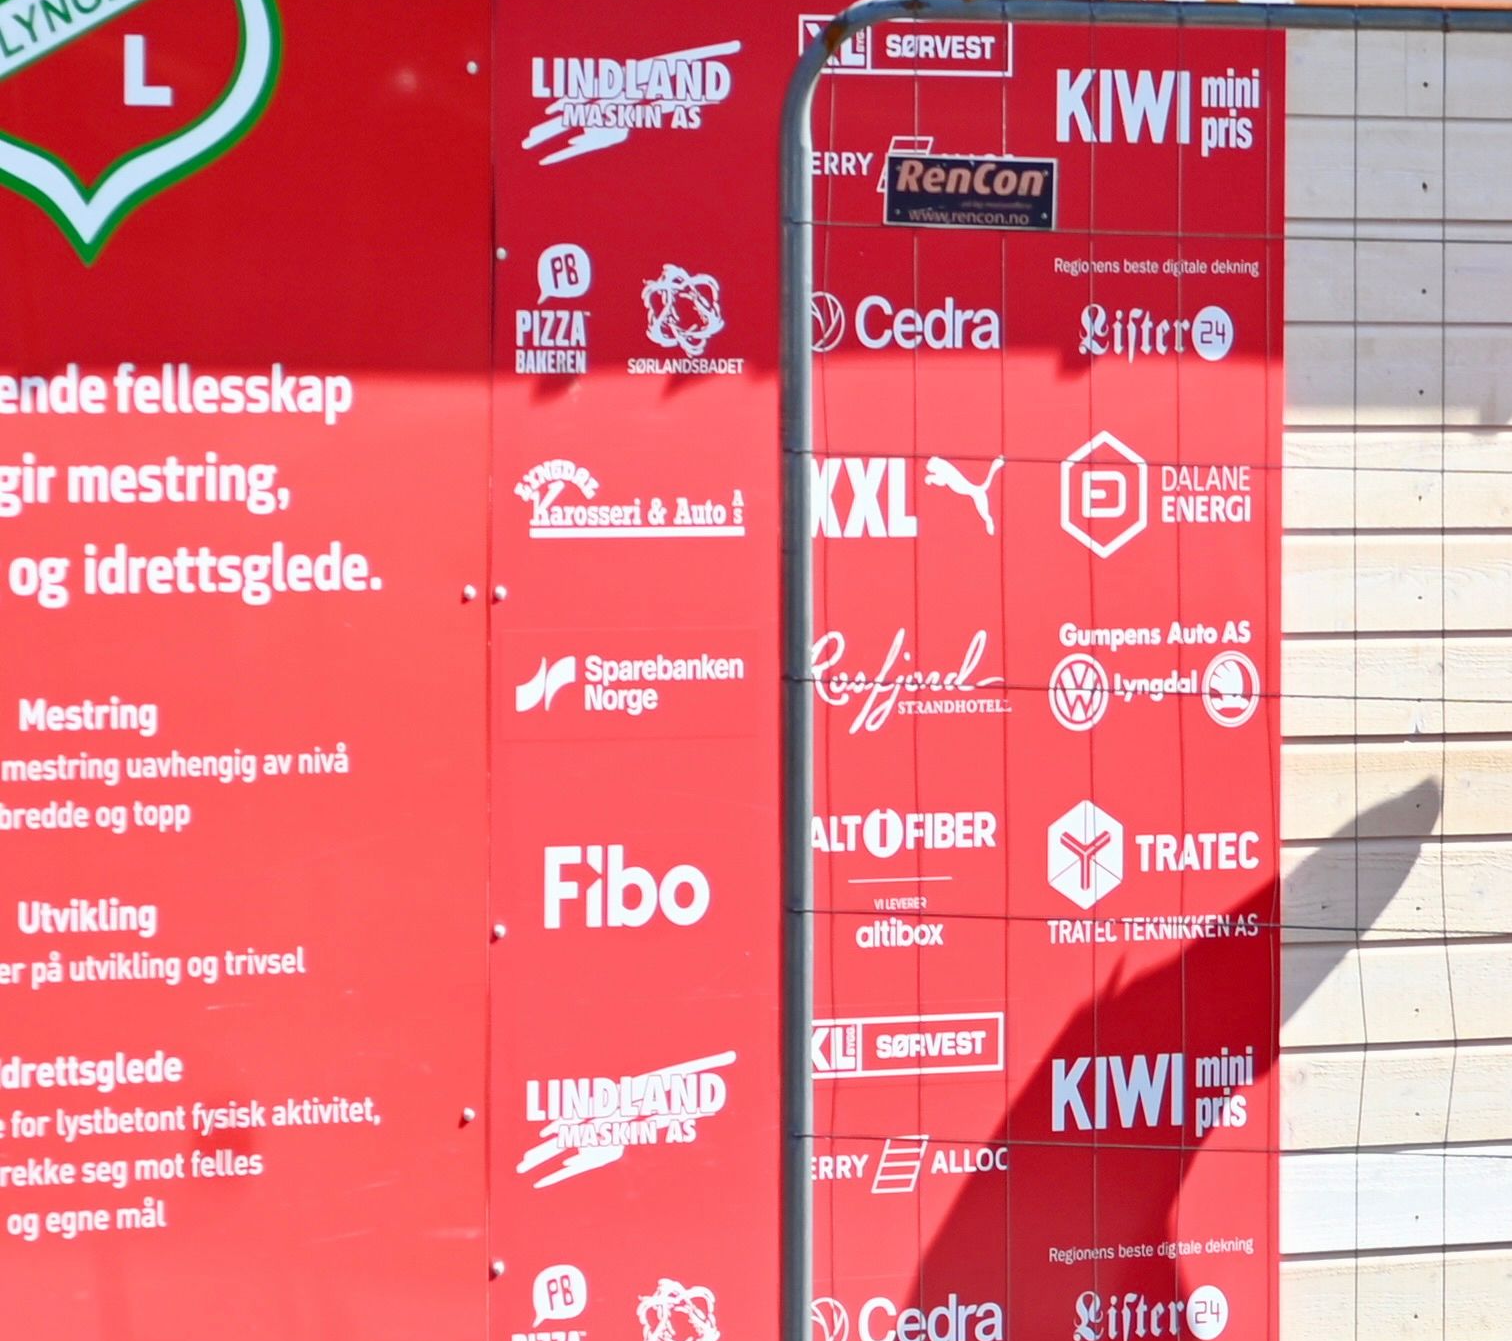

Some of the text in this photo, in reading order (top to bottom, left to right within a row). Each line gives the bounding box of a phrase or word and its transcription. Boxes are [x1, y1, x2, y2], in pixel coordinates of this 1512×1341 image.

[886, 34, 996, 59] SØRVEST
[531, 57, 733, 102] LINDLAND
[1201, 69, 1259, 108] mini
[562, 103, 702, 130] MASKIN AS
[1056, 69, 1191, 143] KIWI
[1201, 108, 1253, 157] pris
[896, 160, 1044, 197] RenCon
[908, 206, 1029, 226] www.rencon.no
[550, 253, 578, 289] PB
[1054, 258, 1259, 278] Regionens beste digitale dekning
[516, 310, 588, 347] PIZZA
[856, 296, 999, 349] Cedra
[1200, 322, 1225, 345] 24
[515, 350, 587, 374] BAKEREN
[627, 358, 744, 374] SØRLANDSBADET
[0, 363, 353, 425] ende fellesskap
[0, 452, 290, 517] gir mestring,
[1161, 465, 1250, 492] DALANE
[530, 482, 726, 527] Karosseri & Auto
[812, 458, 918, 538] XXL
[1161, 495, 1251, 523] ENERGI
[8, 541, 382, 609] og idrettsglede.
[1059, 621, 1251, 651] Gumpens Auto AS
[584, 654, 743, 685] Sparebanken
[1114, 670, 1197, 701] Lyngdal
[19, 696, 158, 737] Mestring
[584, 685, 658, 716] Norge
[1, 742, 350, 786] mestring uavhengig av nivå
[95, 805, 126, 834] og
[133, 801, 191, 833] topp
[1135, 832, 1259, 872] TRATEC
[544, 844, 710, 929] Fibo
[17, 898, 157, 938] Utvikling
[856, 916, 944, 948] altibox
[1048, 914, 1258, 944] TRATEC TEKNIKKEN AS
[31, 951, 63, 991] på
[69, 952, 181, 986] utvikling
[187, 956, 218, 985] og
[225, 946, 306, 975] trivsel
[876, 1031, 987, 1059] SØRVEST
[1196, 1047, 1253, 1088] mini
[526, 1073, 727, 1121] LINDLAND
[1052, 1054, 1182, 1132] KIWI
[11, 1110, 51, 1138] for
[56, 1106, 186, 1143] lystbetont
[192, 1101, 267, 1137] fysisk
[271, 1096, 381, 1127] aktivitet,
[1196, 1088, 1247, 1137] pris
[557, 1119, 697, 1148] MASKIN AS
[0, 1150, 264, 1189] rekke seg mot felles
[931, 1147, 1008, 1174] ALLOC
[7, 1197, 167, 1242] og egne mål
[1049, 1238, 1254, 1265] Regionens beste dekning
[547, 1275, 573, 1310] PB
[1194, 1301, 1221, 1324] 24
